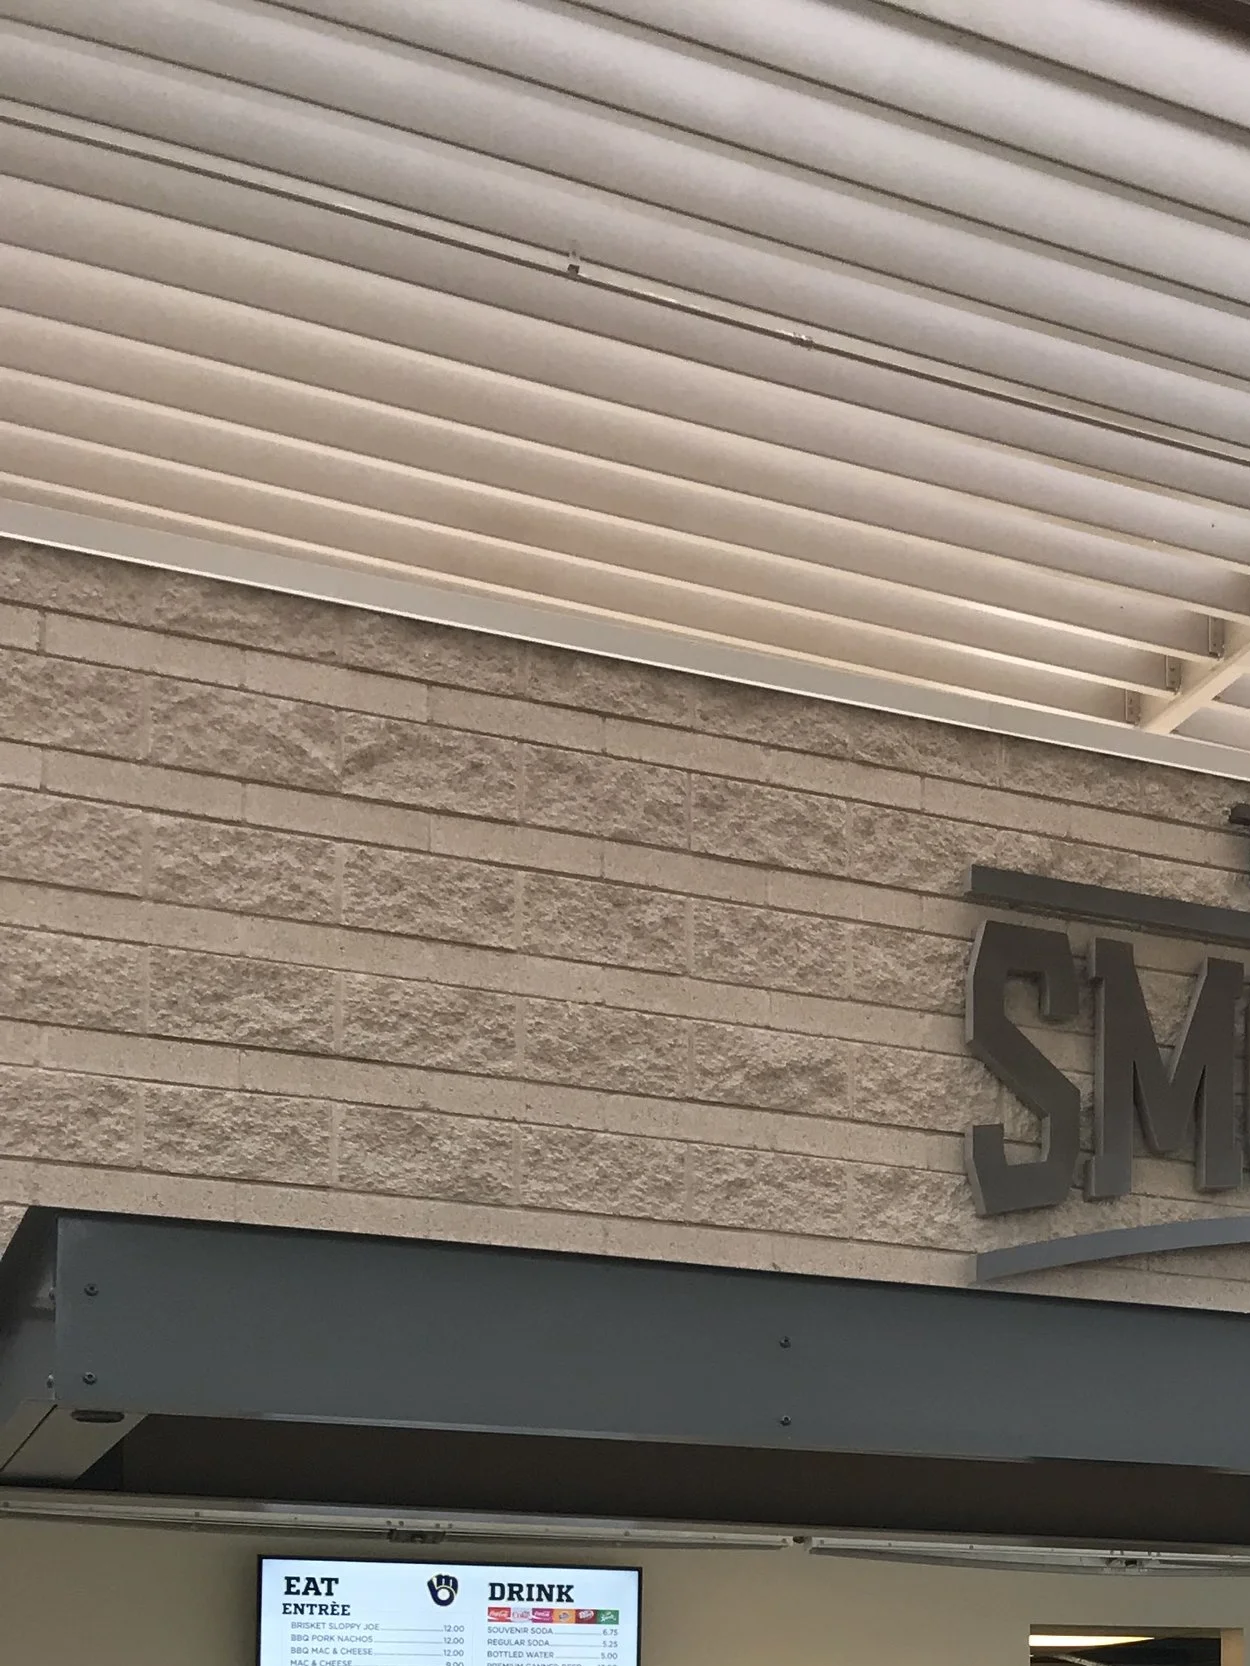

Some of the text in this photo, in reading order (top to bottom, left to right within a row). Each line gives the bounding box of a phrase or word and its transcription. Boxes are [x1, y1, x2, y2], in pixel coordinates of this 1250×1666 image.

[284, 1576, 339, 1596] EAT
[488, 1582, 574, 1602] DRINK
[282, 1601, 351, 1616] ENTRÈE
[291, 1622, 326, 1630] BRISKET
[328, 1622, 360, 1631] SLOPPY
[444, 1625, 464, 1633] 12.00
[488, 1626, 618, 1636] SOUVENIR SODA 6.75
[291, 1634, 464, 1645] BBQ PORK NACHOS 12.00
[487, 1638, 526, 1646] REGULAR
[528, 1639, 550, 1647] SODA
[291, 1647, 309, 1655] BBQ
[311, 1647, 330, 1655] MAC
[332, 1647, 338, 1655] &
[340, 1648, 373, 1656] CHEESE
[487, 1650, 524, 1658] BOTTLED
[600, 1652, 618, 1660] 5.00
